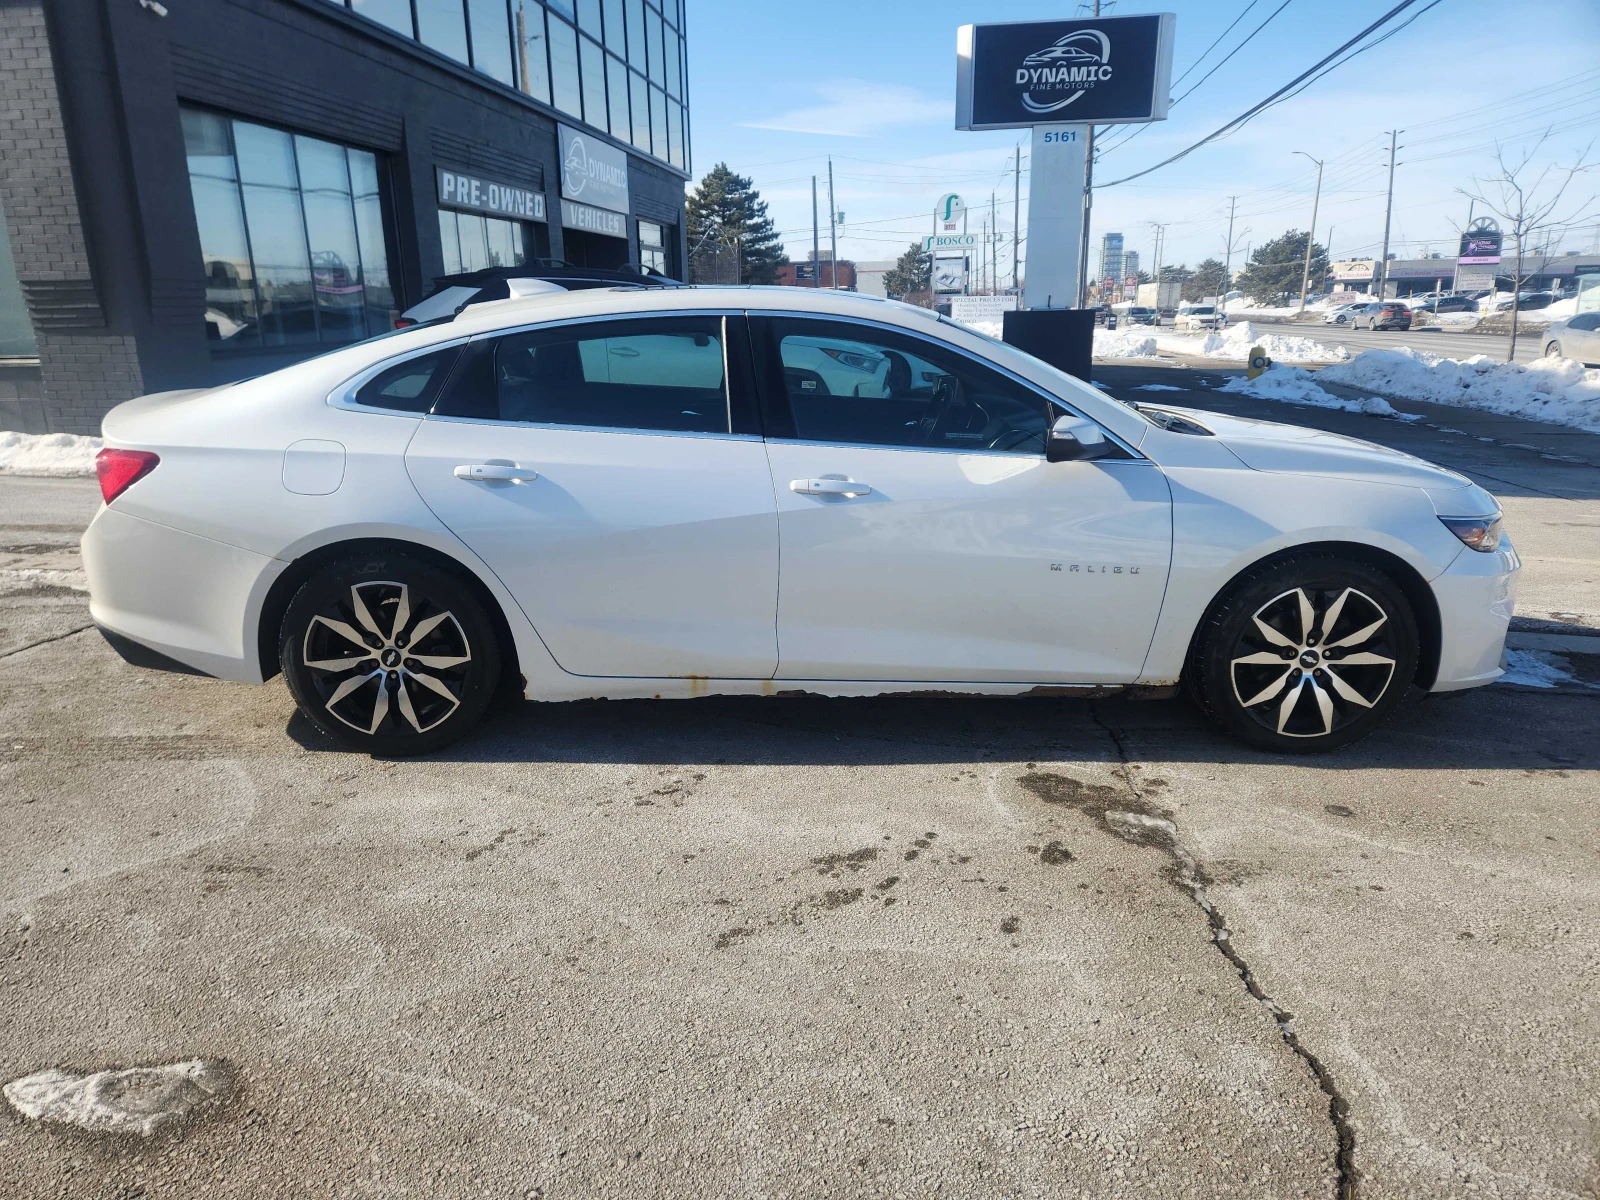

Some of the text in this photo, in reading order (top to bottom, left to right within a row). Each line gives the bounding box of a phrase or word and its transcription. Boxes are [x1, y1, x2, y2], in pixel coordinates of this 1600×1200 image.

[1015, 65, 1113, 84] DYNAMIC
[1030, 81, 1095, 91] FINE MOTORS
[1044, 131, 1076, 143] 5161
[588, 157, 627, 189] DYNAMIC
[442, 172, 545, 218] PRE-OWNED
[570, 204, 619, 233] VEHICLES
[936, 235, 975, 246] BOSCO
[1050, 563, 1140, 575] MALIBU
